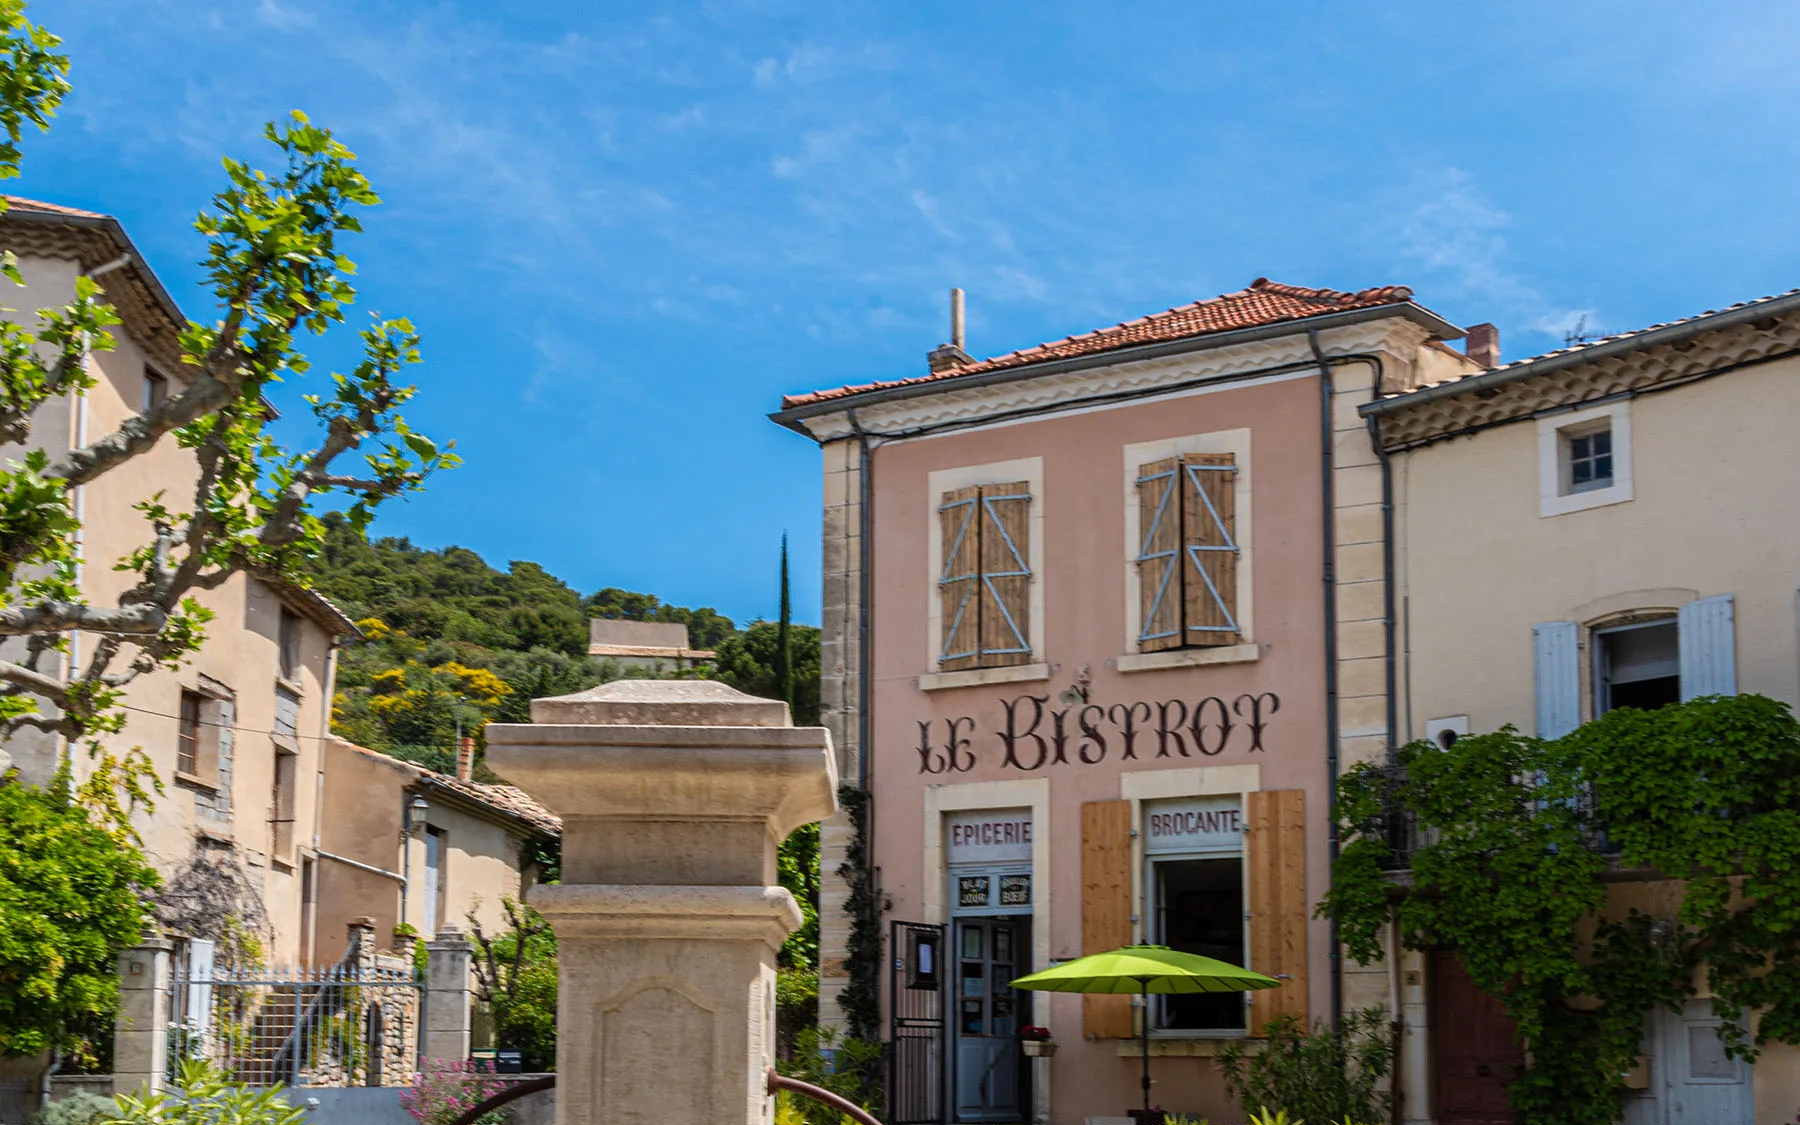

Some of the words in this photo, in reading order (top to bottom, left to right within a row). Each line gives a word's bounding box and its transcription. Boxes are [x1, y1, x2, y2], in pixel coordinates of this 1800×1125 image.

[915, 716, 976, 774] LE
[995, 692, 1280, 771] BISTROT
[953, 822, 1032, 847] EPICERIE
[1150, 810, 1240, 837] BROCANTE
